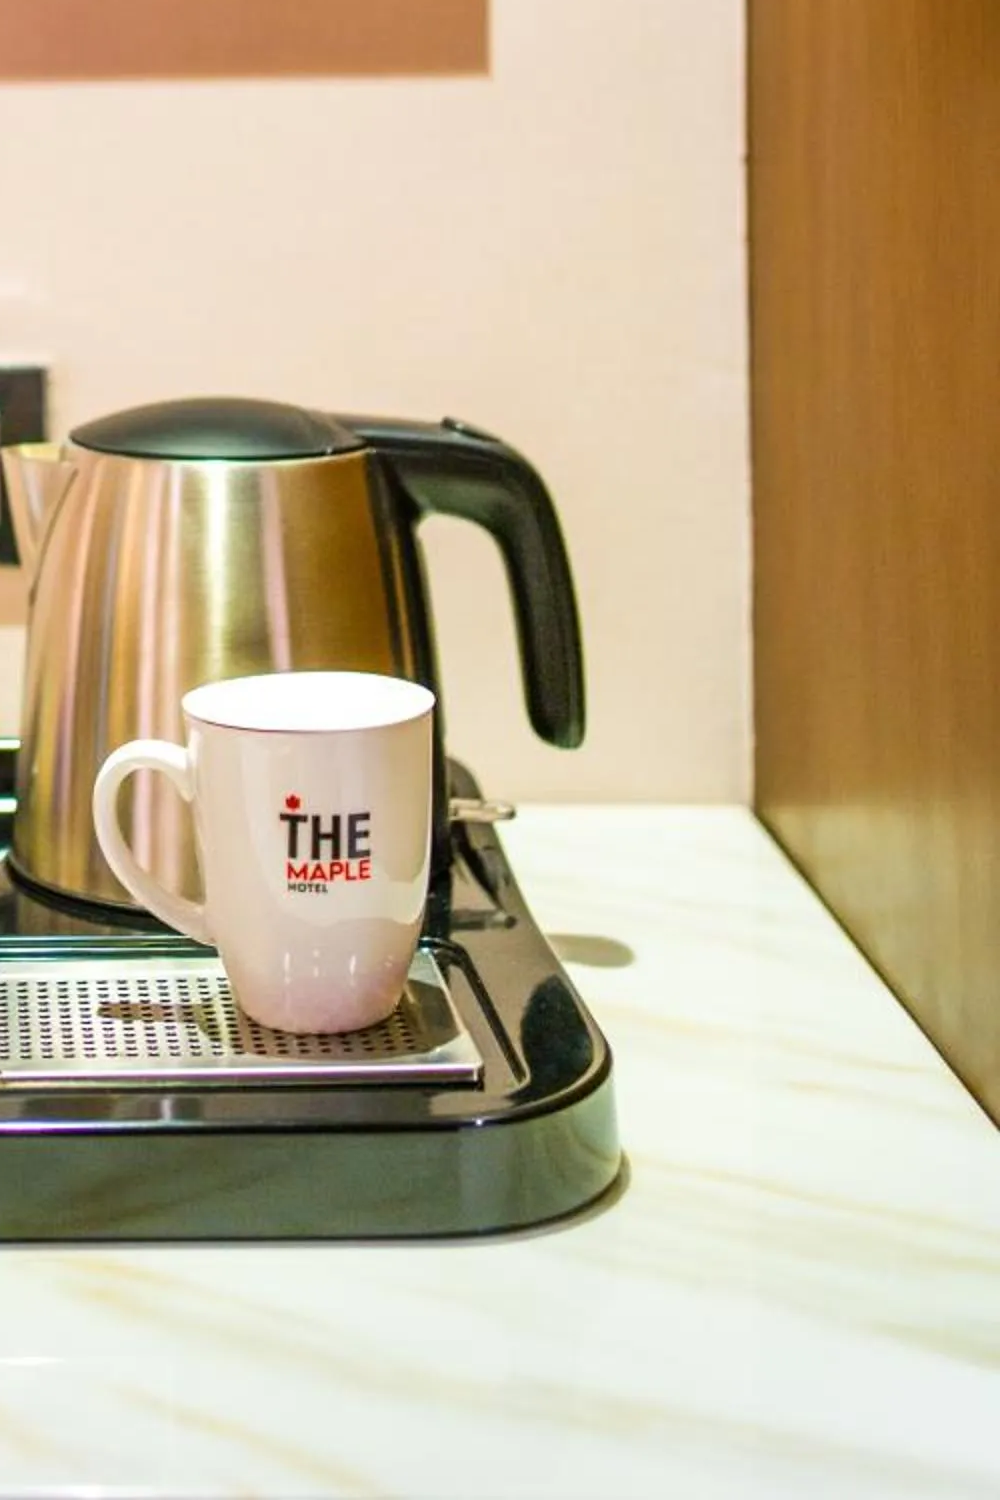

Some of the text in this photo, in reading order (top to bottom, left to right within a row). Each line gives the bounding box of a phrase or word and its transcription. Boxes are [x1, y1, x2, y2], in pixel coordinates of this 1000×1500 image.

[279, 812, 371, 860] THE
[287, 860, 371, 881] MAPLE
[287, 883, 328, 893] HOTEL
